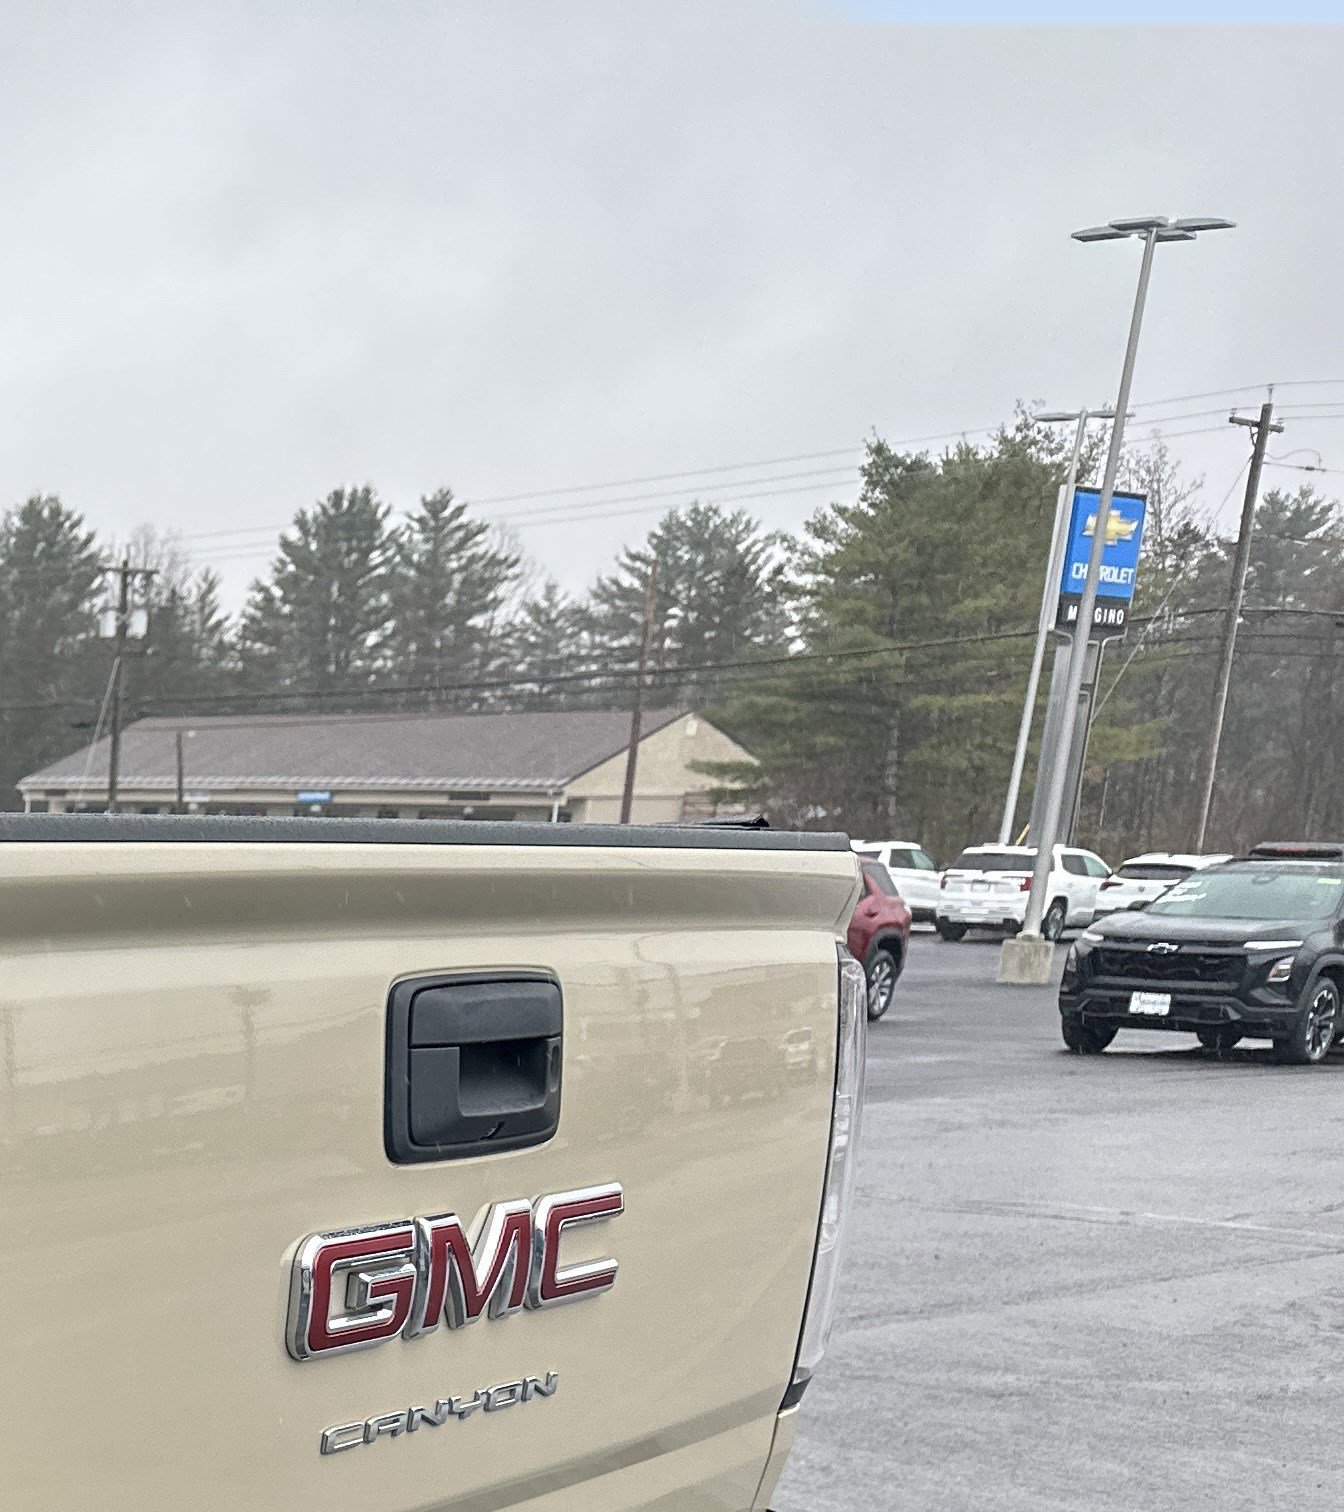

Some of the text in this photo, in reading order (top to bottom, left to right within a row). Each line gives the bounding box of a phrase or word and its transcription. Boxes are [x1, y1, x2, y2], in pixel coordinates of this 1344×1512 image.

[1072, 562, 1134, 584] CHROLET
[1068, 605, 1125, 625] MGINO
[286, 1182, 625, 1361] GMC
[319, 1371, 559, 1455] CANYON
